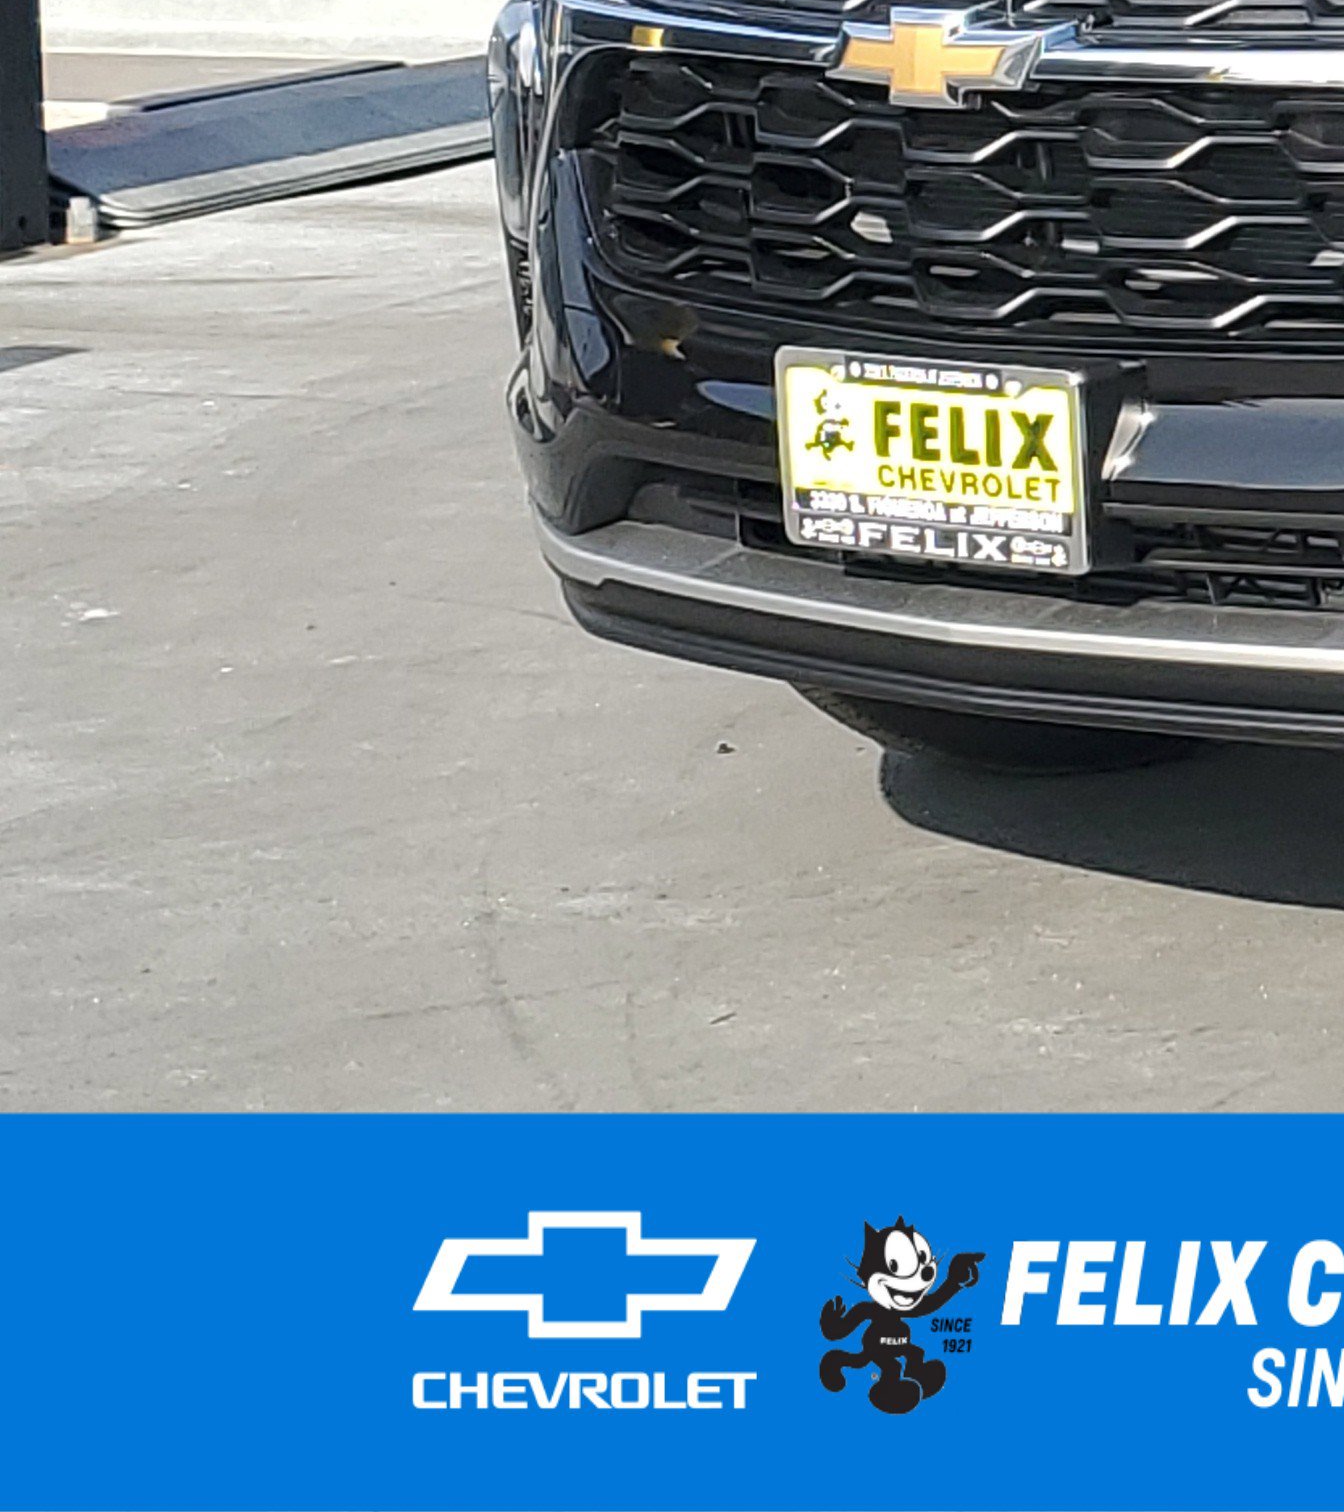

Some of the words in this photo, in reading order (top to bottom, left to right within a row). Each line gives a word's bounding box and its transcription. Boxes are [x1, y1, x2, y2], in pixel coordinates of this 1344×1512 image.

[873, 400, 1059, 473] FELIX
[878, 464, 1062, 503] CHEVROLET
[858, 521, 1009, 562] FELIX
